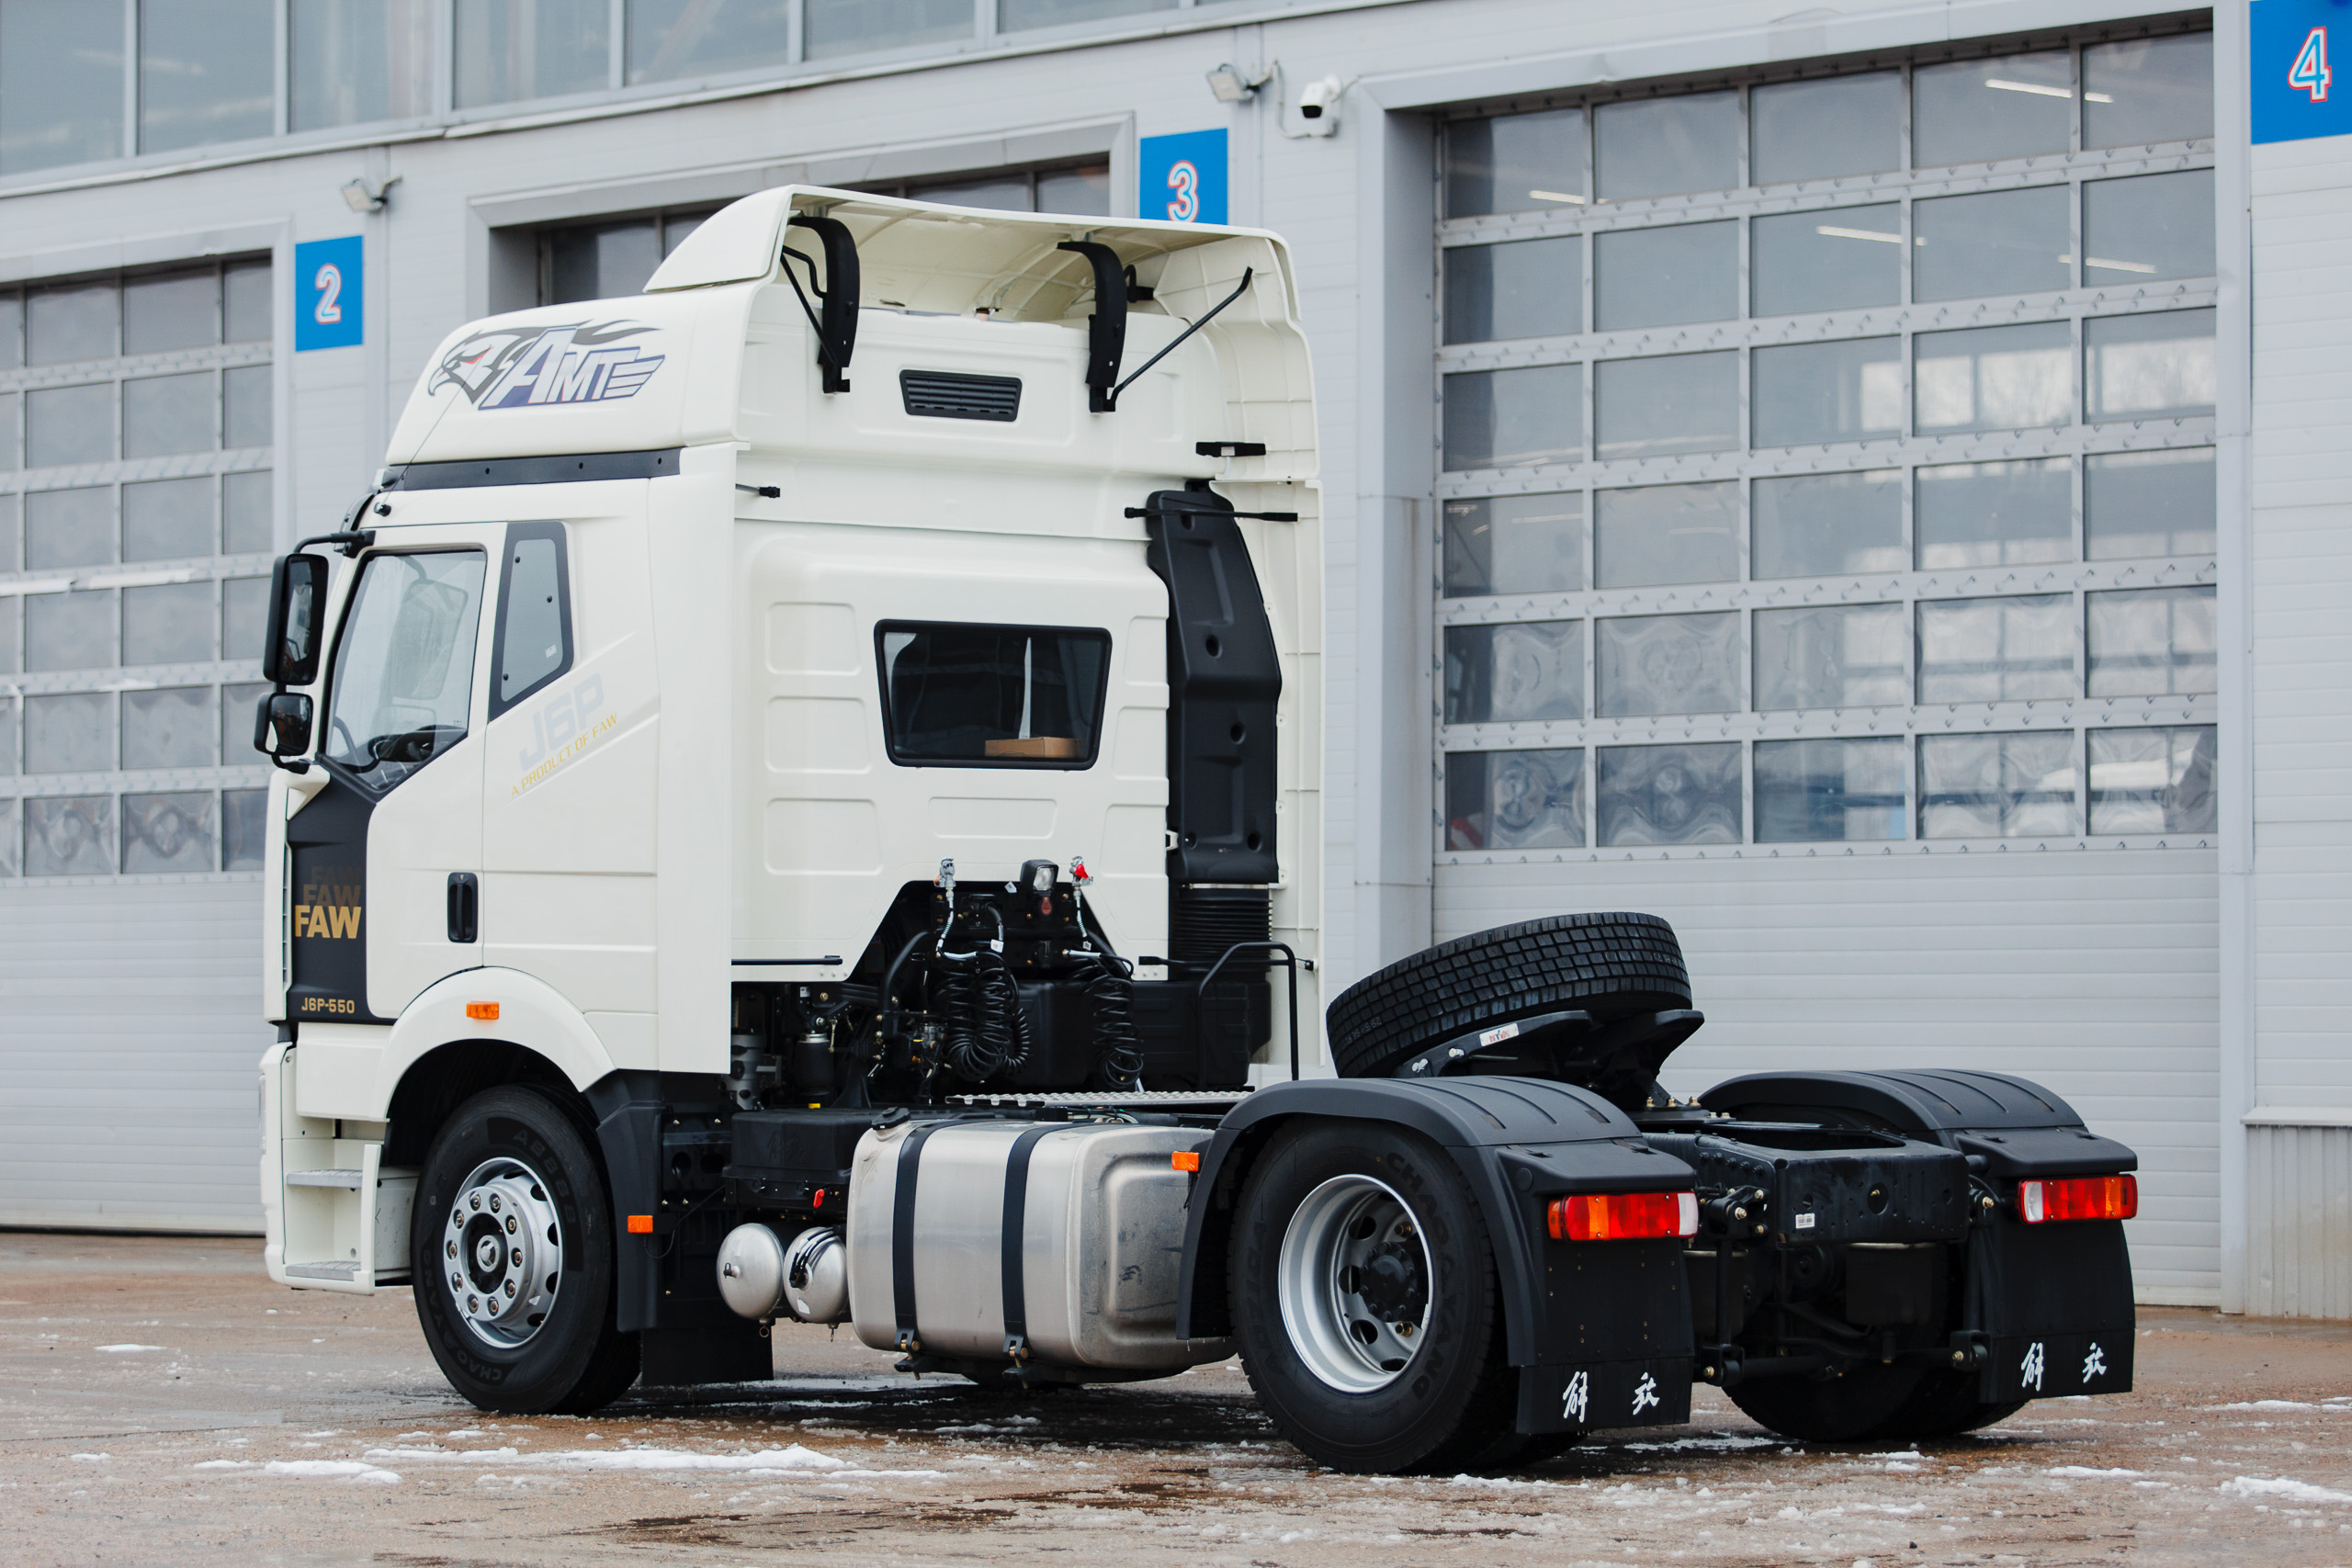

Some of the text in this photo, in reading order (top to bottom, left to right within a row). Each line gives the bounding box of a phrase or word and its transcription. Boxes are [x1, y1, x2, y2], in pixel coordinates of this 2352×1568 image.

[2288, 26, 2332, 103] 4
[1167, 160, 1199, 222] 3
[315, 263, 342, 324] 2
[519, 672, 605, 771] J6P
[511, 712, 618, 799] A PRODUCT OF FAW
[295, 905, 362, 939] FAW
[303, 884, 361, 908] FAW
[301, 998, 356, 1014] J6P-550
[1385, 1152, 1460, 1400] CHAO YANG
